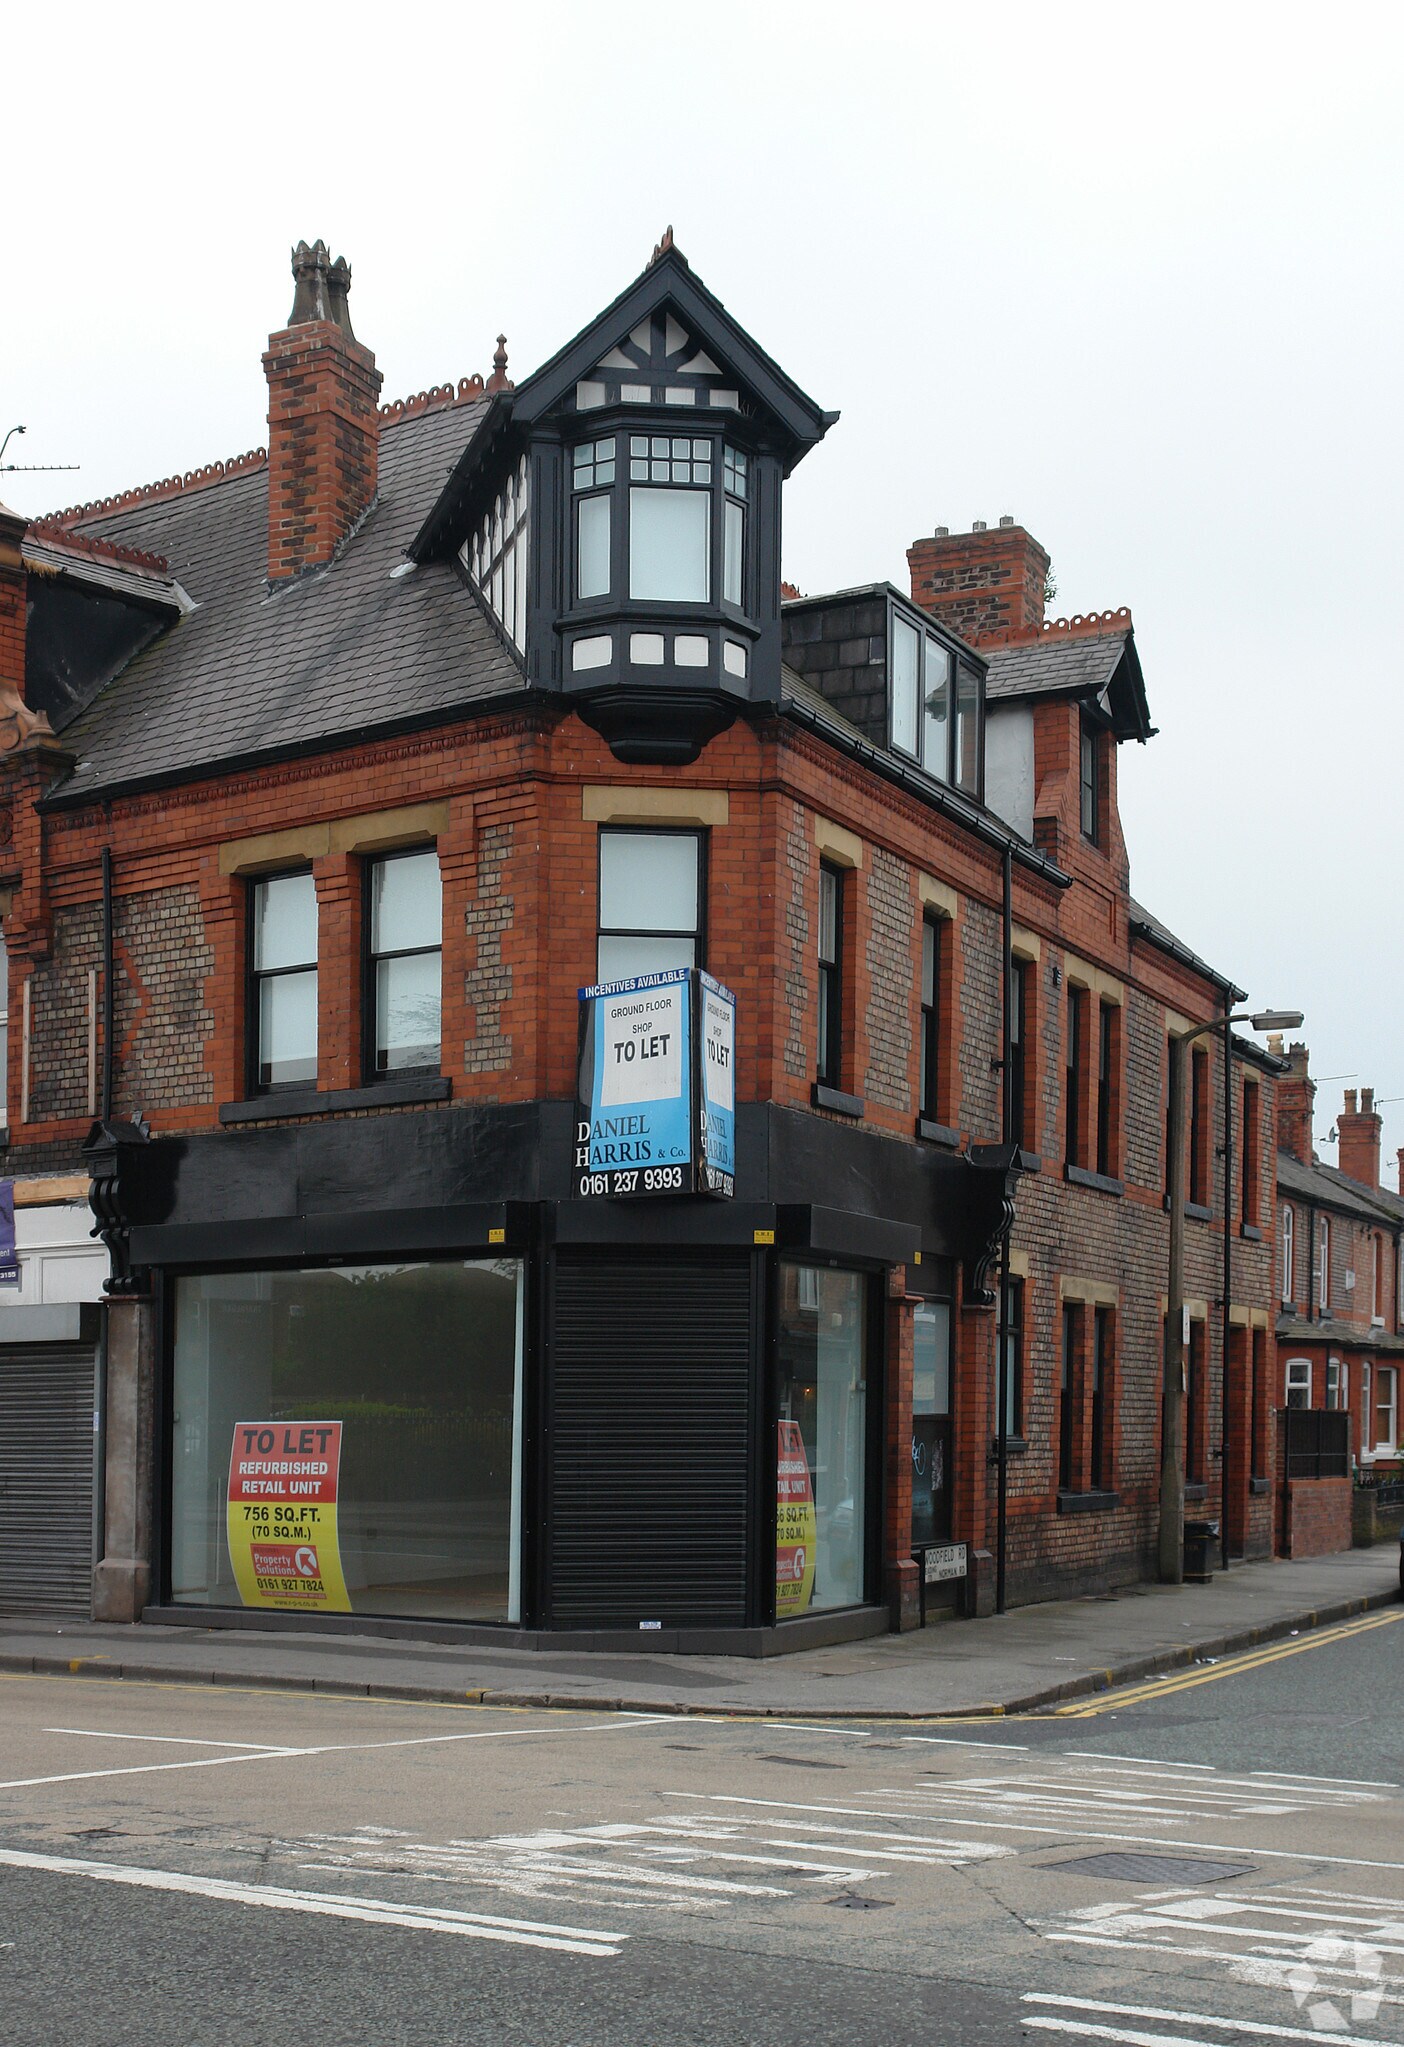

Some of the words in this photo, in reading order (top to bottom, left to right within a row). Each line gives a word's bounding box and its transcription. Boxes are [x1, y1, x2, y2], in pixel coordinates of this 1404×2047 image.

[585, 978, 636, 998] INCENTIVES
[637, 969, 685, 988] AVAILABLE
[611, 1004, 644, 1019] GROUND
[646, 999, 672, 1012] FLOOR
[632, 1022, 653, 1034] SHOP
[614, 1040, 635, 1063] TO
[640, 1034, 670, 1060] LET
[707, 1038, 715, 1062] TO
[716, 1043, 730, 1068] LET
[577, 1114, 650, 1142] DANIEL
[575, 1140, 651, 1168] HARRIS
[658, 1149, 665, 1158] &
[670, 1146, 686, 1158] Co.
[580, 1174, 609, 1196] 0161
[614, 1170, 639, 1193] 237
[644, 1167, 682, 1190] 9393
[243, 1429, 275, 1454] TO
[283, 1429, 333, 1454] LET
[239, 1461, 328, 1475] REFURBISHED
[241, 1480, 286, 1494] RETAIL
[289, 1481, 322, 1494] UNIT
[791, 1480, 806, 1494] UNIT
[243, 1506, 269, 1521] 756
[274, 1506, 320, 1523] SQ.FT.
[786, 1506, 809, 1523] SQ.FT.
[252, 1525, 270, 1540] (70
[273, 1526, 311, 1541] SQ.M.)
[254, 1553, 291, 1567] Property
[959, 1547, 966, 1559] RD
[256, 1563, 296, 1576] Solutions
[959, 1565, 965, 1575] RD
[257, 1577, 279, 1590] 0161
[281, 1578, 298, 1591] 927
[300, 1579, 324, 1592] 7824
